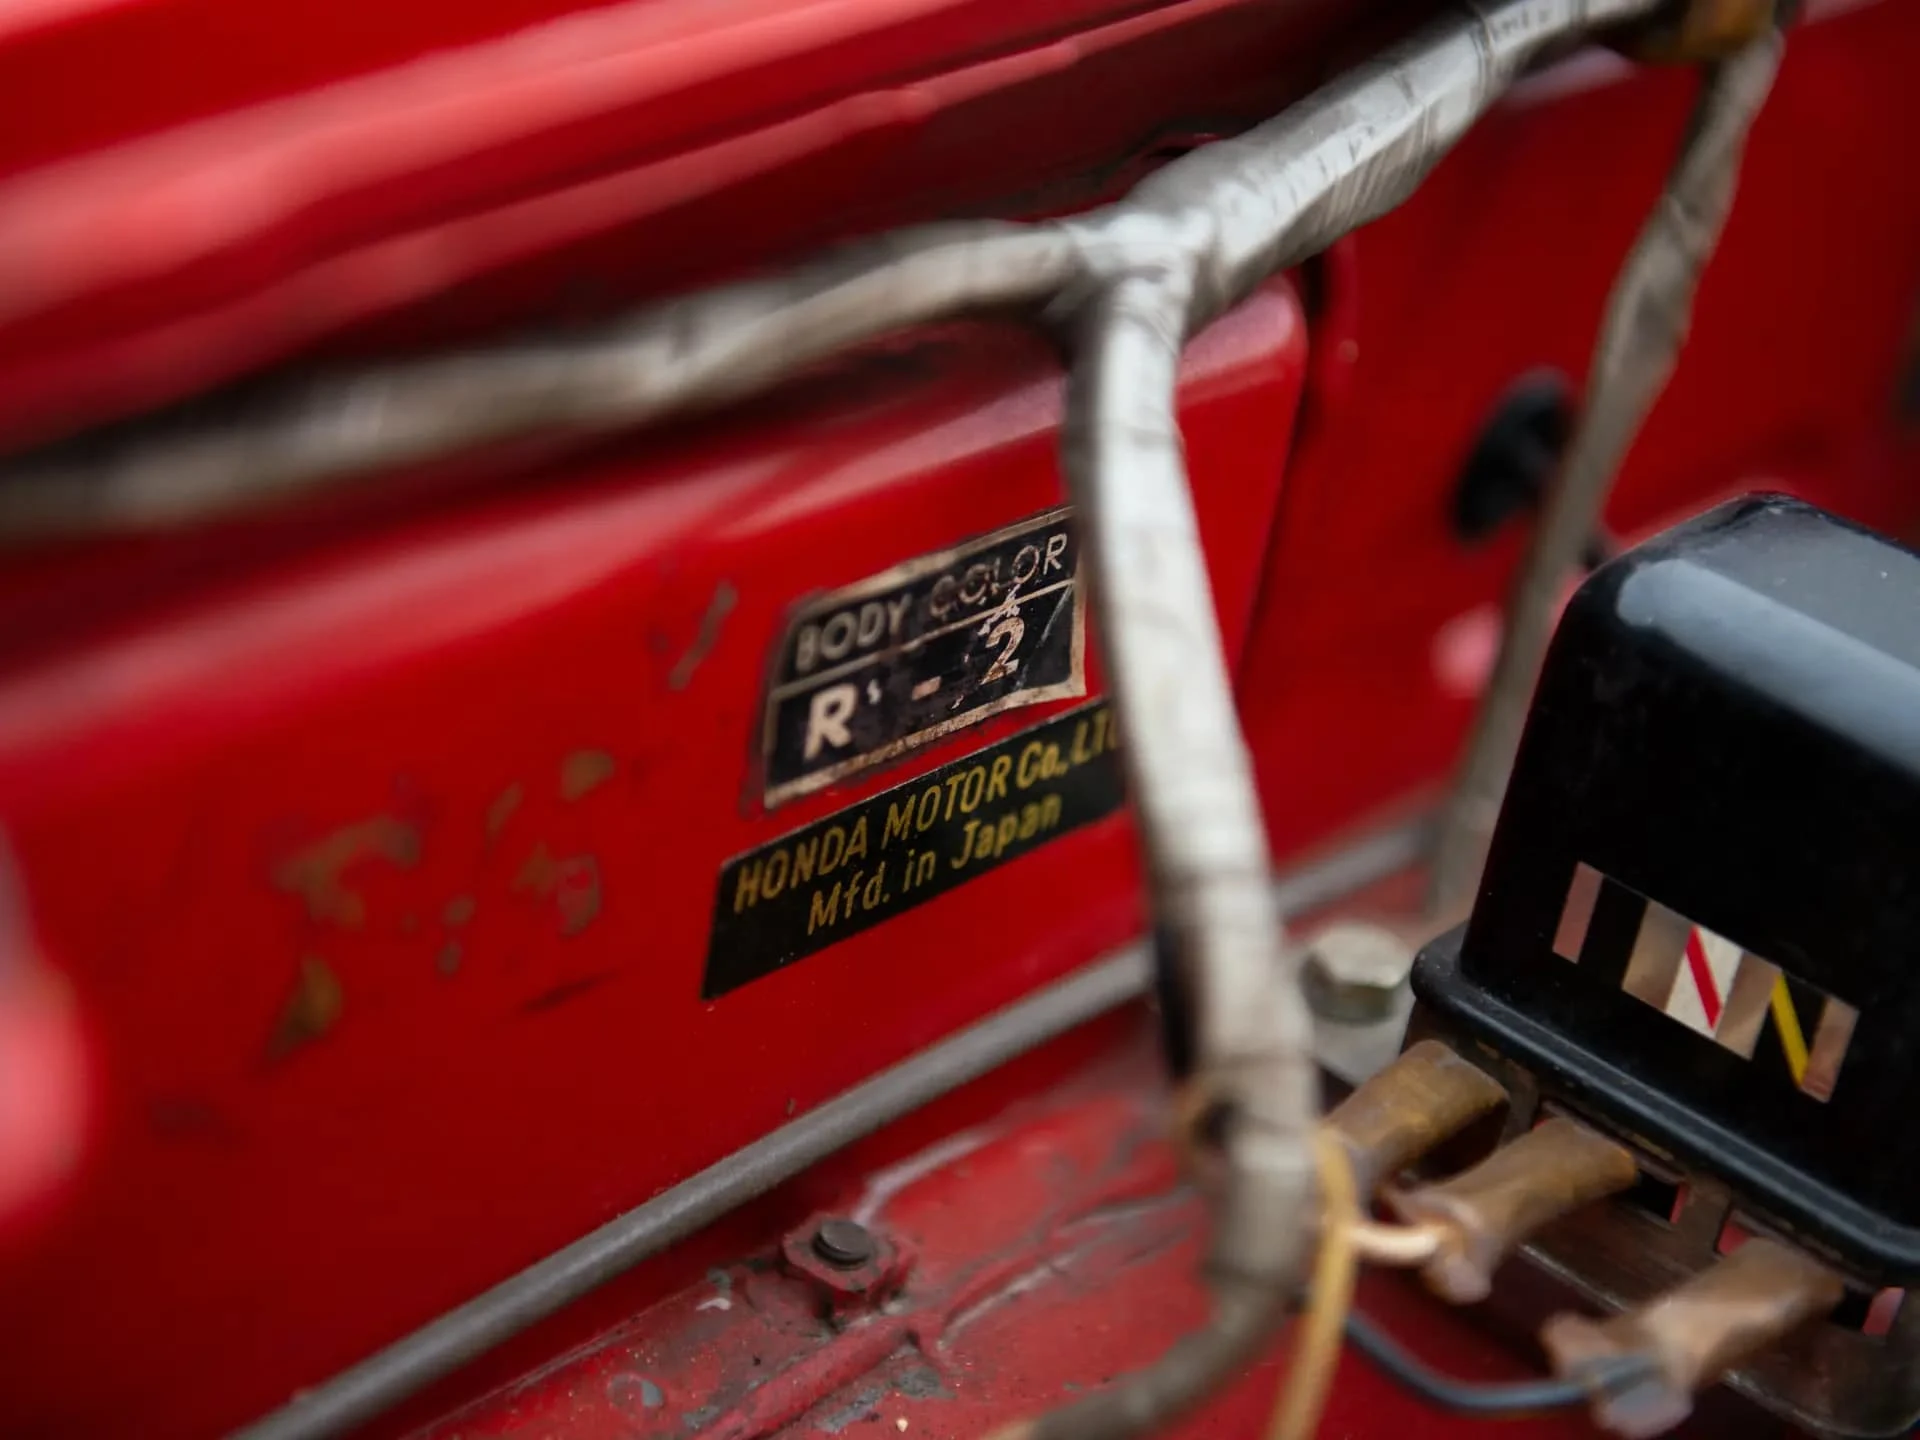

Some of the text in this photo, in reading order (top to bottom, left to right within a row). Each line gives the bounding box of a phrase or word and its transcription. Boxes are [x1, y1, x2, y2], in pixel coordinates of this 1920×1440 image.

[796, 594, 912, 671] BODY
[804, 682, 857, 761] R
[982, 616, 1025, 687] 2
[733, 816, 868, 914] HONDA
[880, 754, 1013, 849] MOTOR
[808, 794, 1062, 936] Mfd. in Japan
